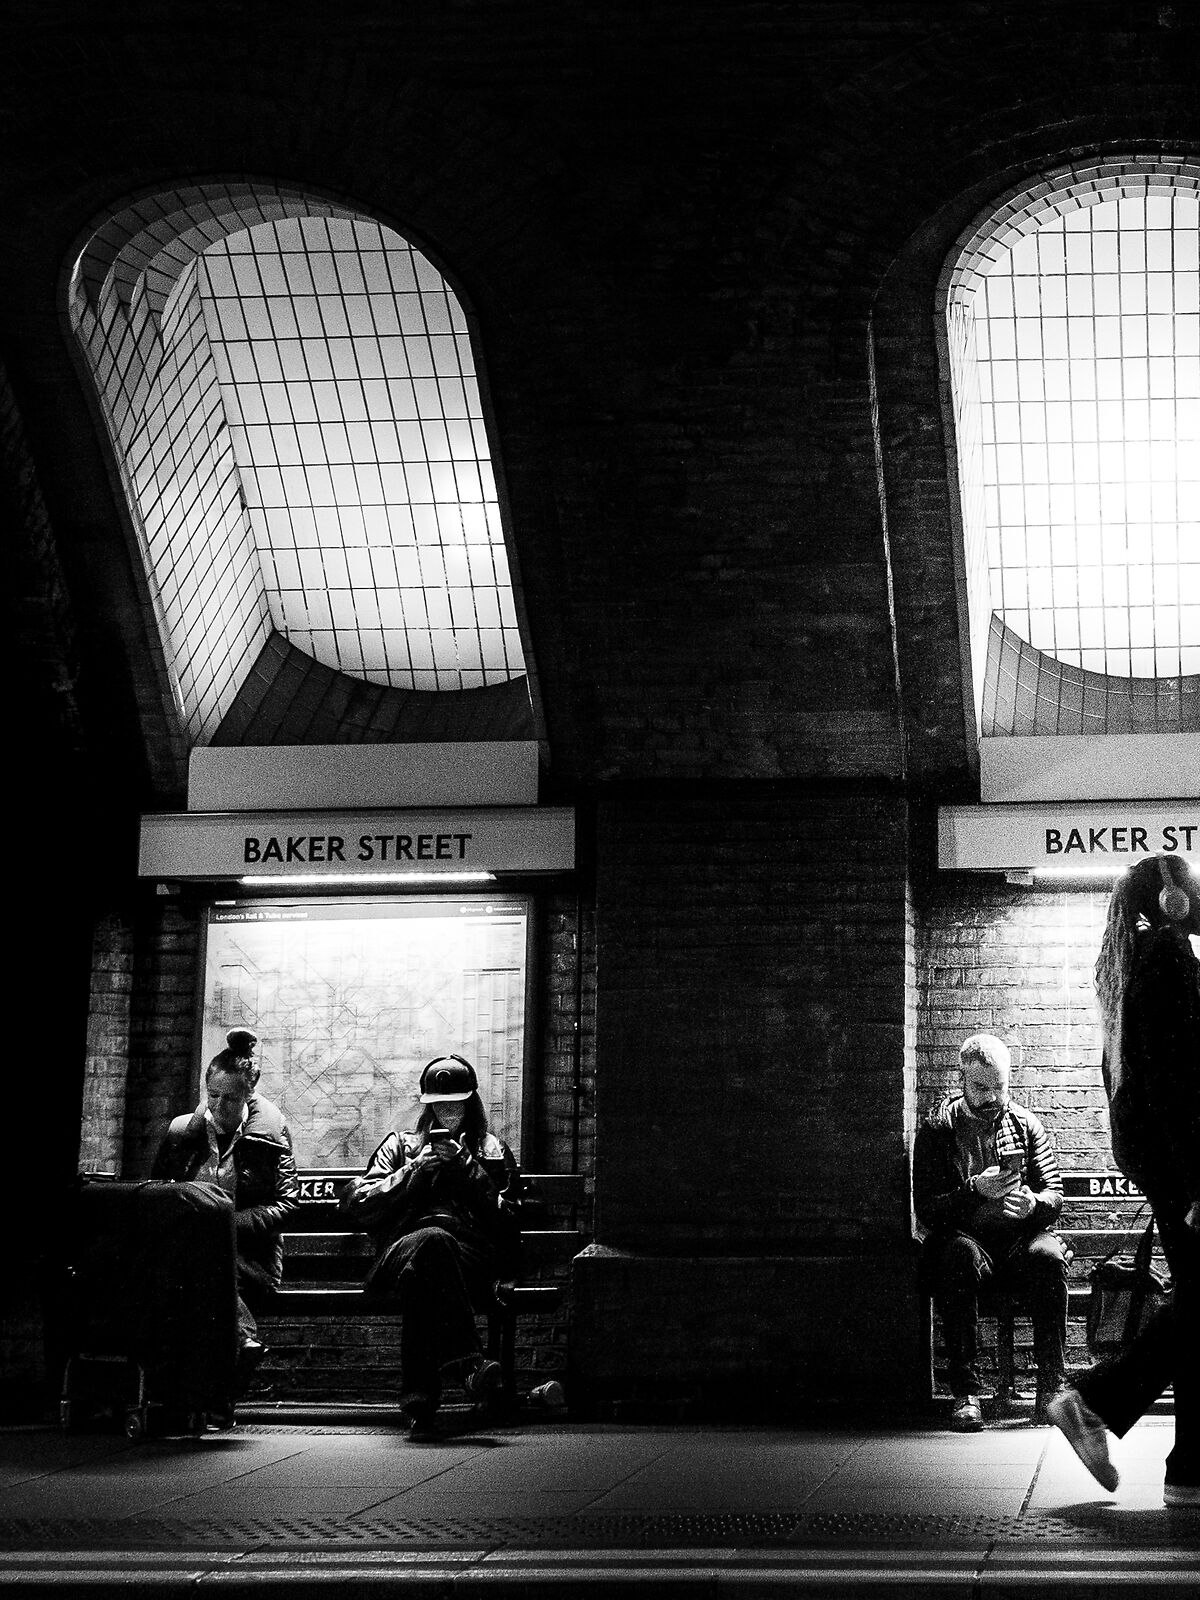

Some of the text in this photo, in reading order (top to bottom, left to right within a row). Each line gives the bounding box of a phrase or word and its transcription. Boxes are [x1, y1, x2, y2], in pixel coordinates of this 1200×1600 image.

[244, 833, 472, 863] BAKER STREET
[1045, 827, 1150, 854] BAKER
[215, 913, 244, 921] London's
[300, 1181, 335, 1197] KER
[1089, 1178, 1143, 1195] BAKE
